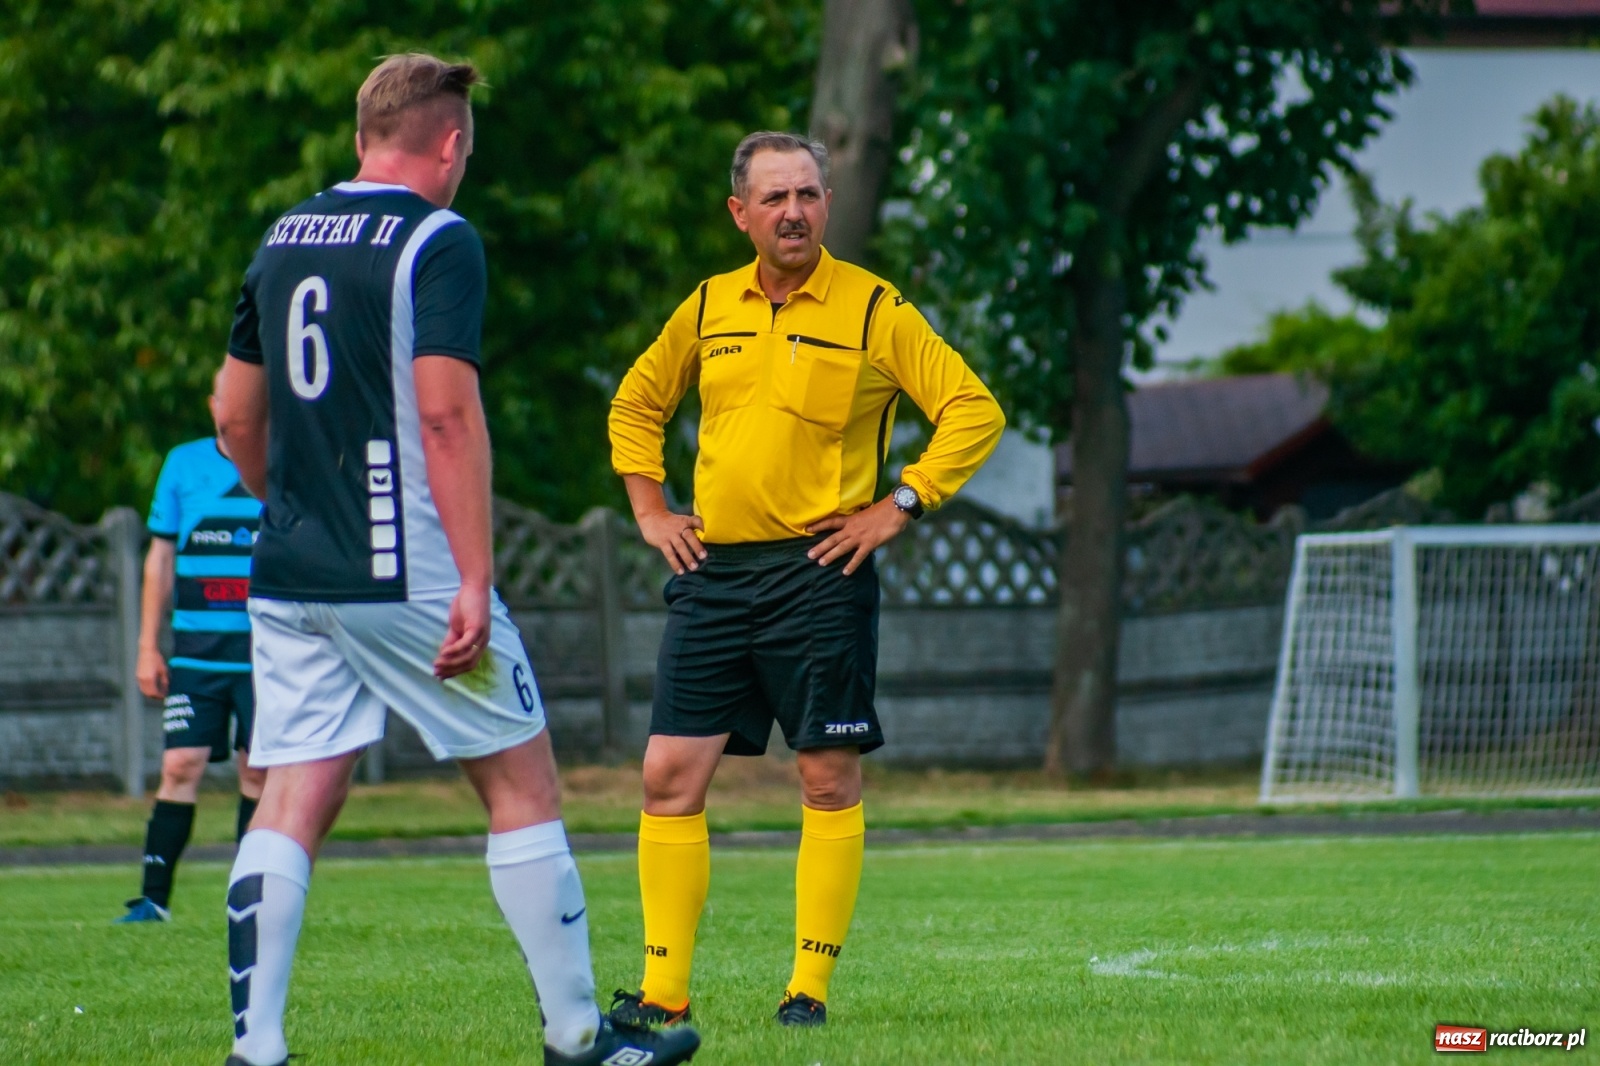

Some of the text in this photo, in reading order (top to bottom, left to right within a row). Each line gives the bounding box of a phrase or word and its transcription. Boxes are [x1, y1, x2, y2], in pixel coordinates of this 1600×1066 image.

[267, 213, 404, 246] SZTEFAN II
[287, 275, 330, 400] 6
[512, 662, 534, 713] 6
[825, 722, 869, 734] zina
[644, 944, 668, 958] na
